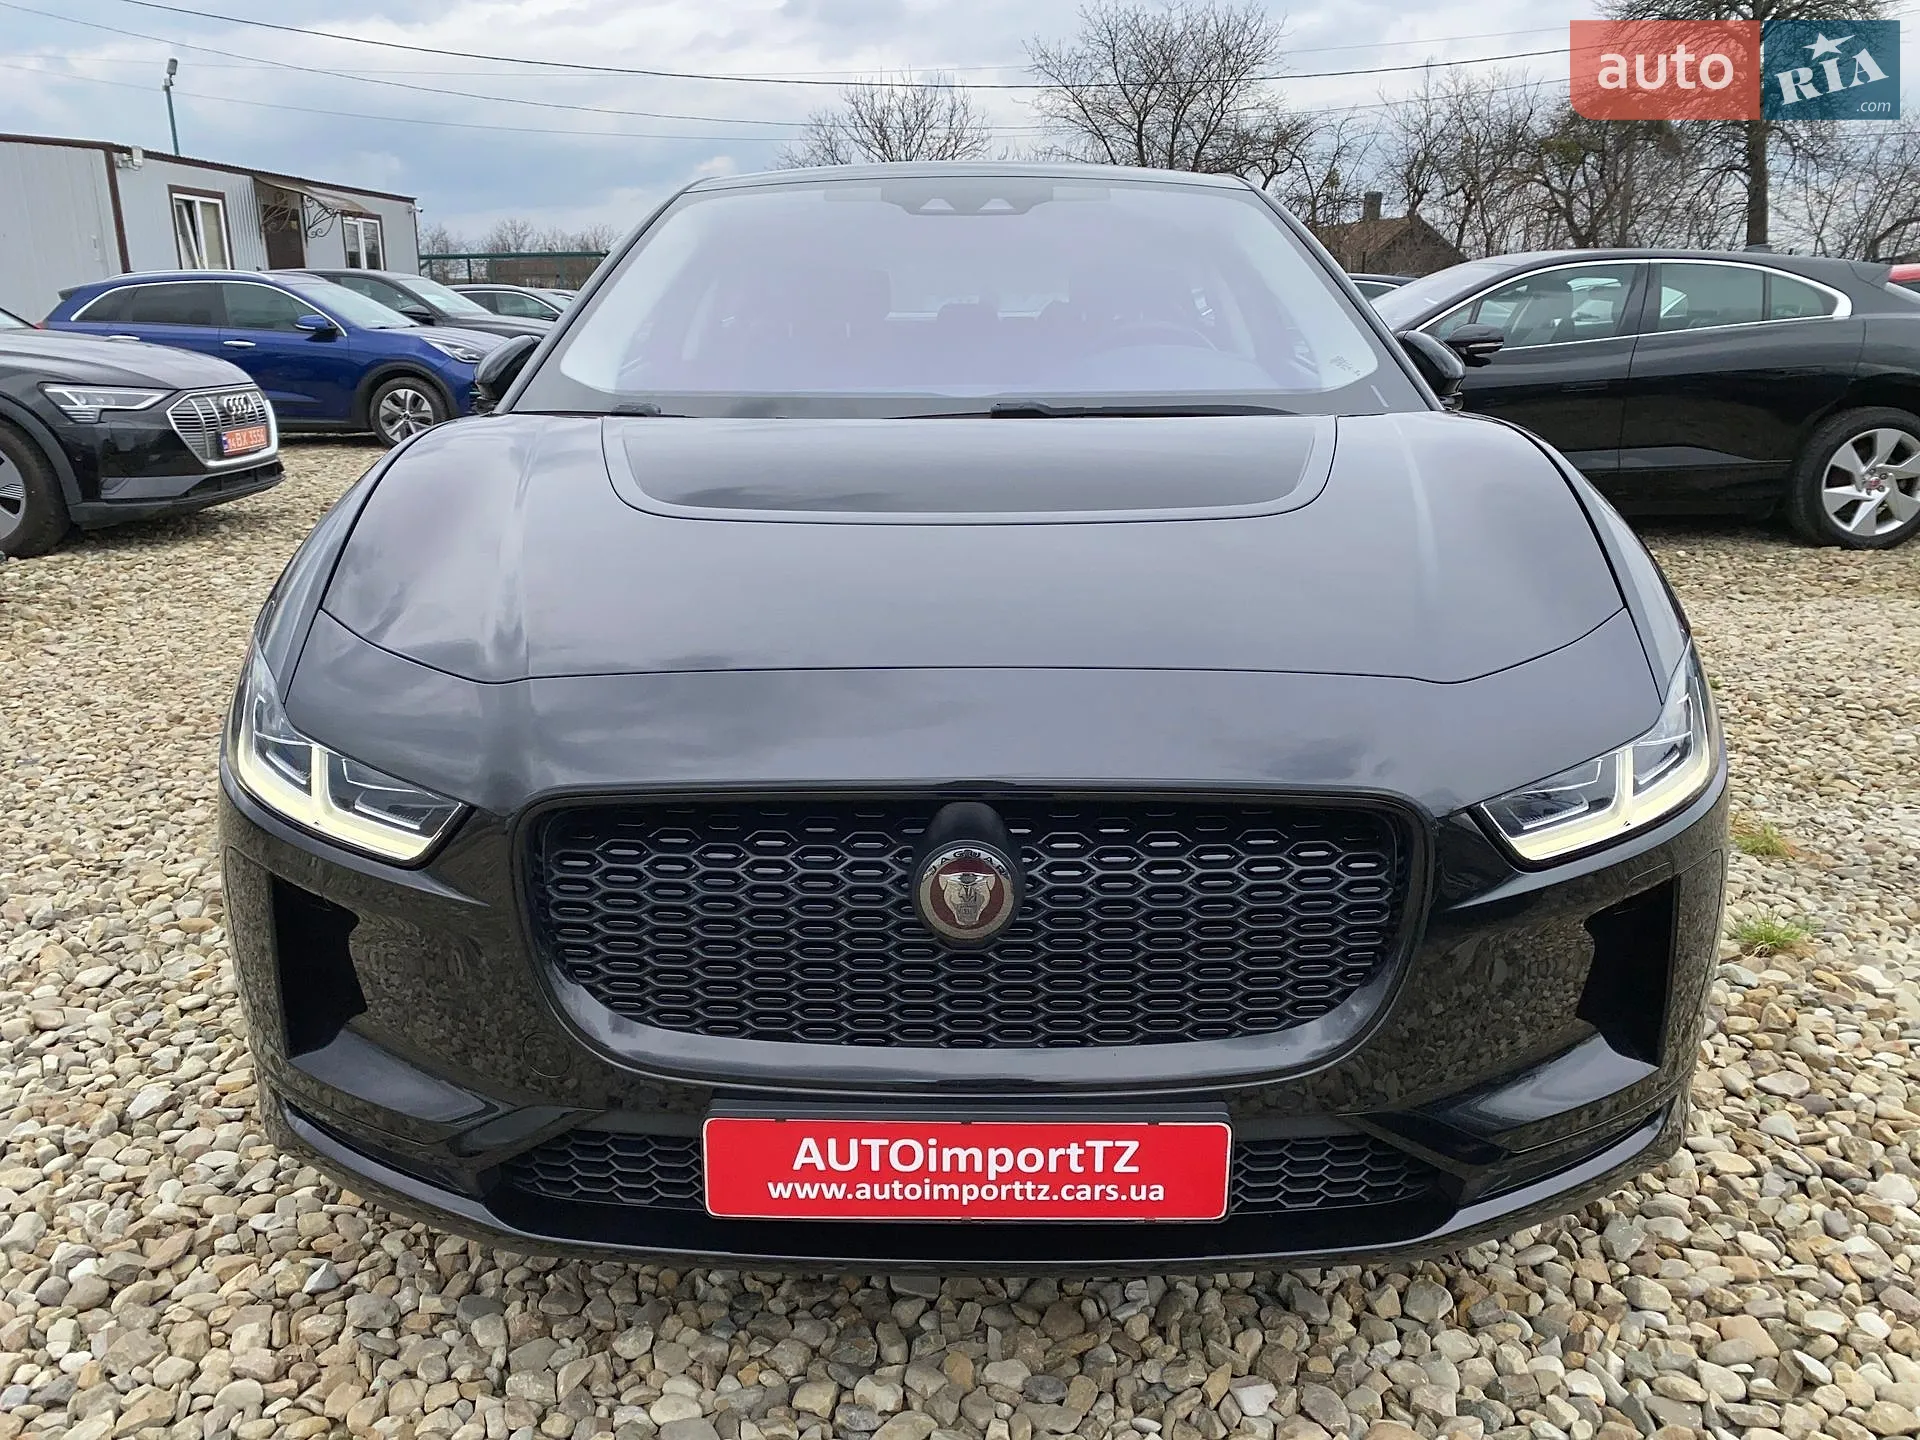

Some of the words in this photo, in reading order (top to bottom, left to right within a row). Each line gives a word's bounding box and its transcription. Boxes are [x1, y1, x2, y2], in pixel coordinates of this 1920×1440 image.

[922, 849, 1010, 882] JAGUAR
[792, 1137, 1140, 1180] AUTOimportTZ
[767, 1178, 1165, 1205] www.autoimporttz.cars.ua
